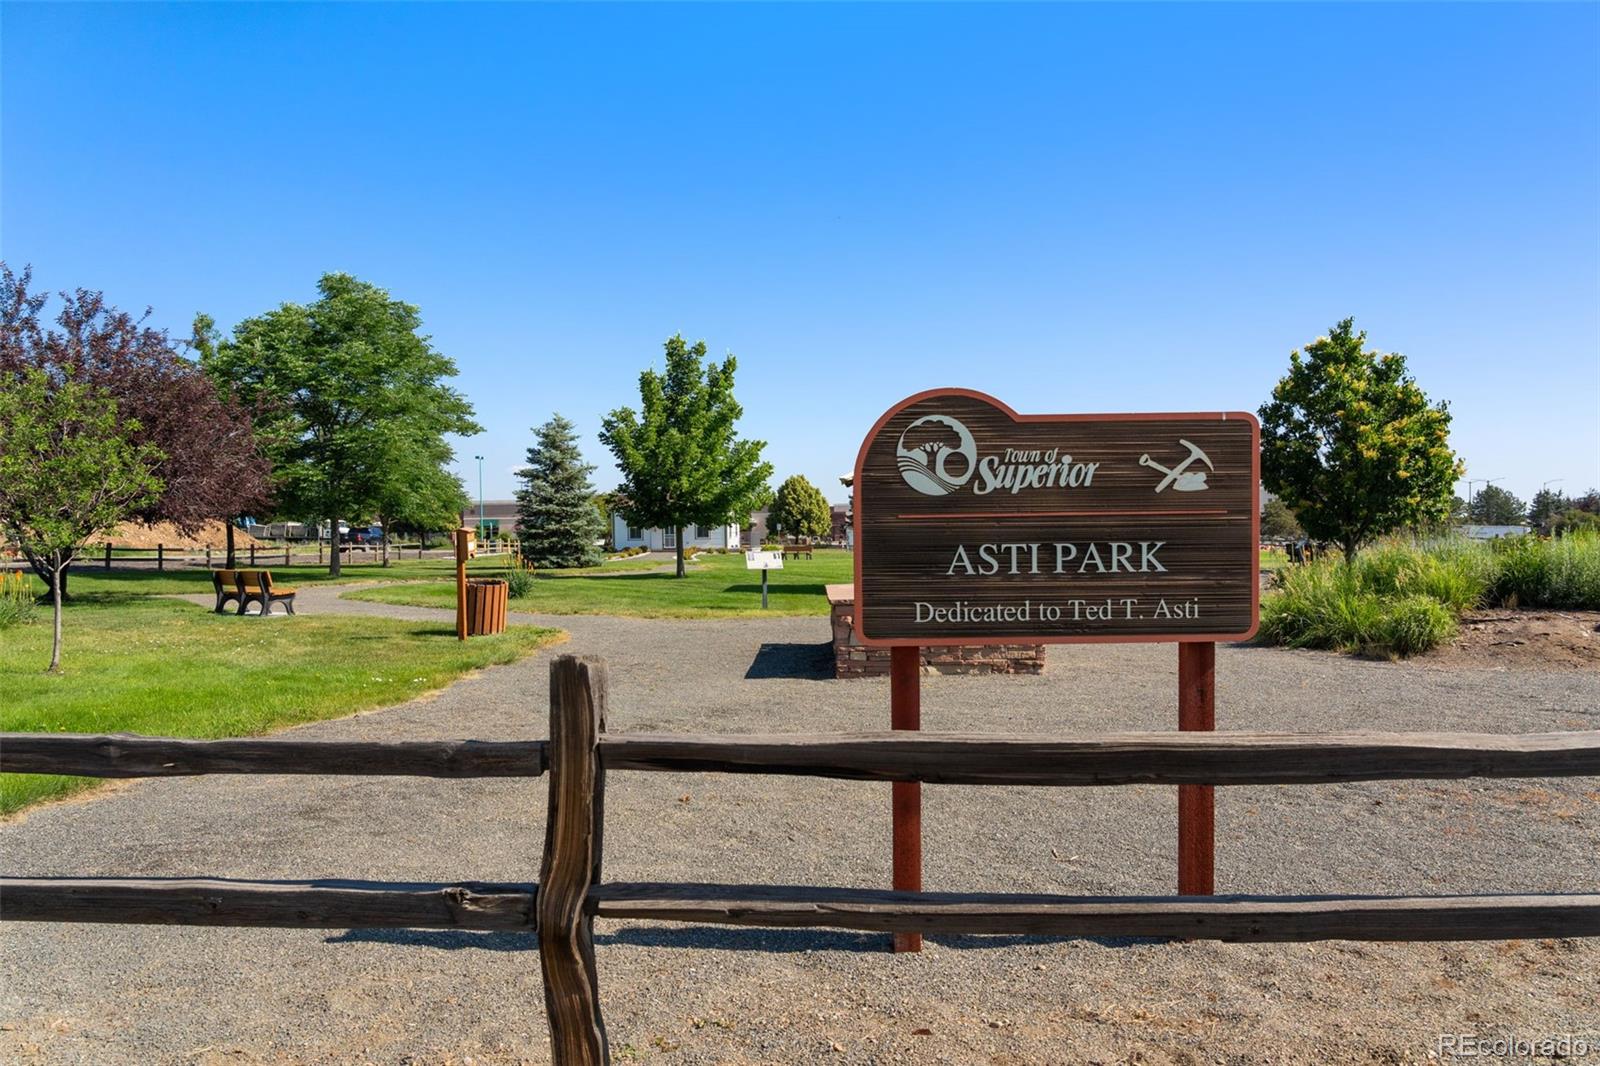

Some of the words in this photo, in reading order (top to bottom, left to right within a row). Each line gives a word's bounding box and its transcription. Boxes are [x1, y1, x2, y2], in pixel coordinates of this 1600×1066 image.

[1003, 448, 1040, 464] Town
[1041, 447, 1059, 467] of
[974, 455, 1098, 494] Superior
[946, 543, 1041, 575] ASTI
[1054, 541, 1168, 574] PARK
[914, 601, 1032, 623] Dedicated
[1039, 606, 1061, 622] to
[1068, 599, 1112, 621] Ted
[1120, 599, 1144, 620] T.
[1153, 597, 1200, 619] Asti
